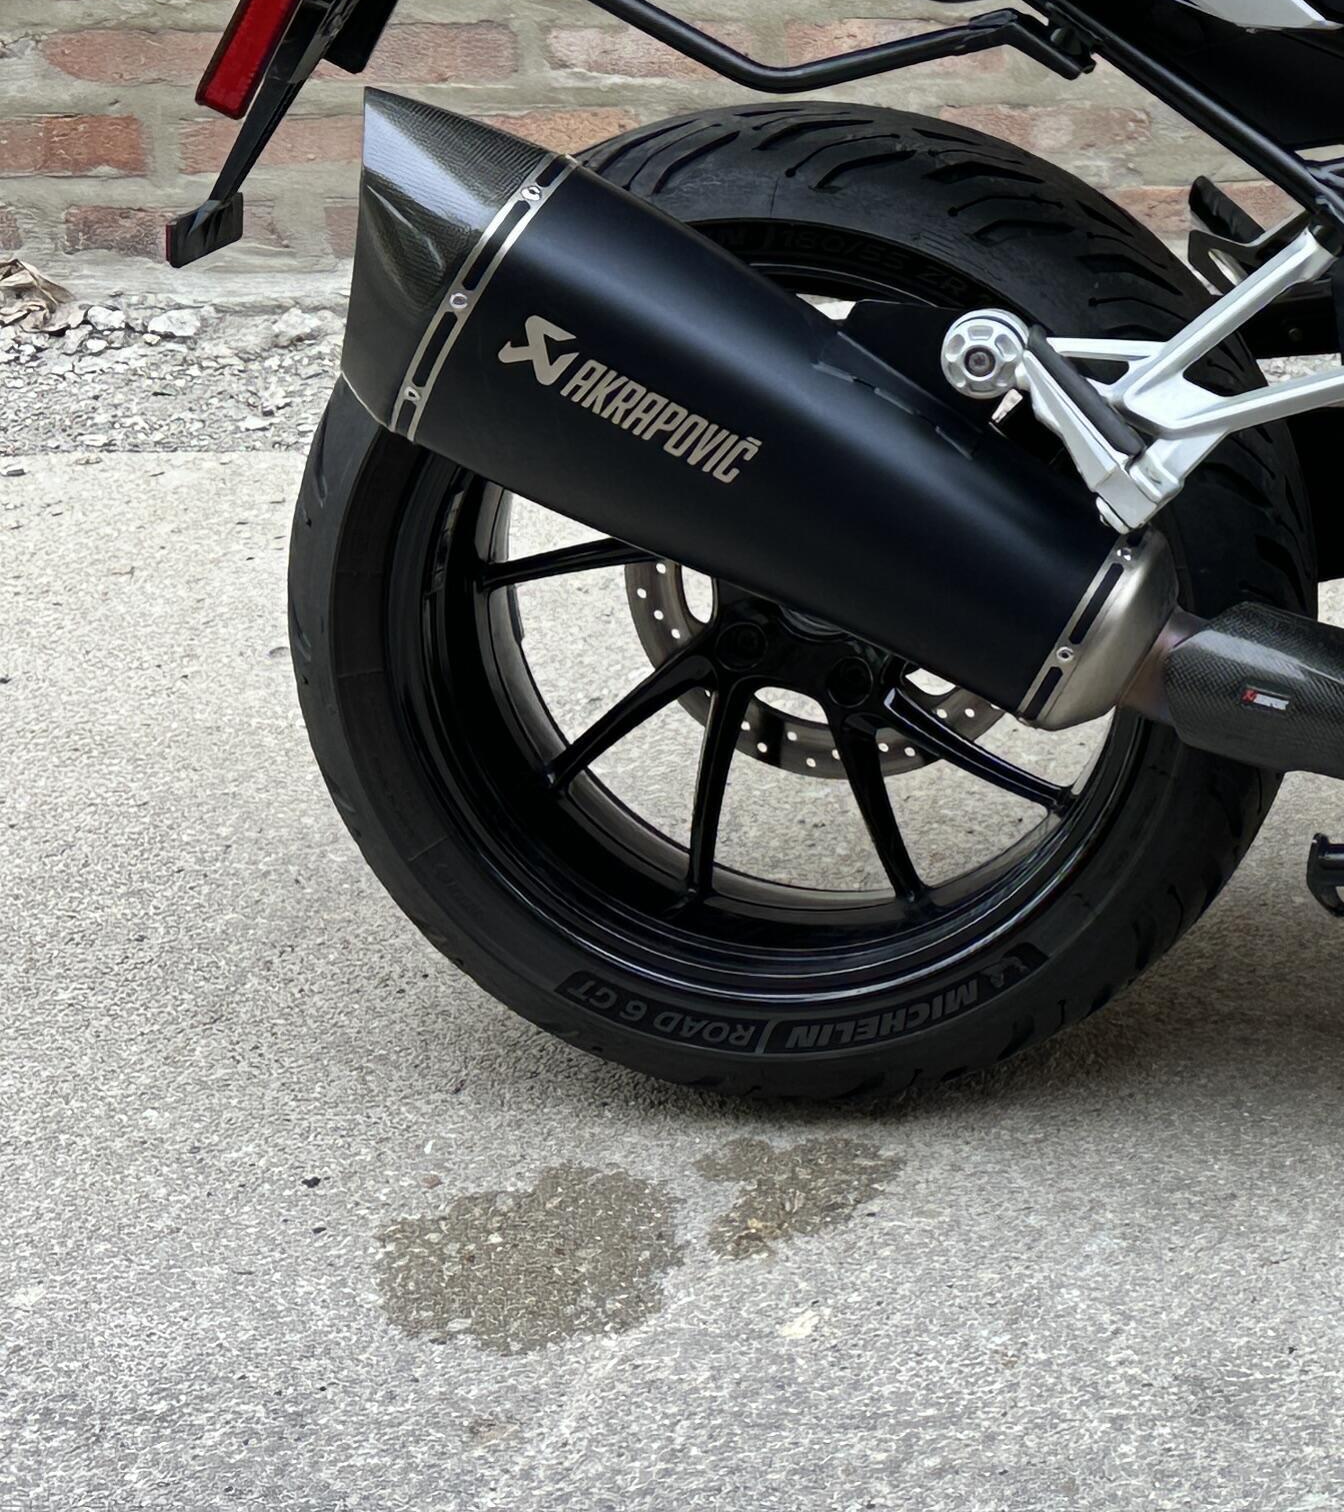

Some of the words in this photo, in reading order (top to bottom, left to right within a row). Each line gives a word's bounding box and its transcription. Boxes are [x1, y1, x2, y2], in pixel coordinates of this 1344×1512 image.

[572, 979, 618, 1011] GT
[618, 999, 645, 1024] 6
[653, 1012, 756, 1048] ROAD
[785, 979, 979, 1050] MICHELIN
